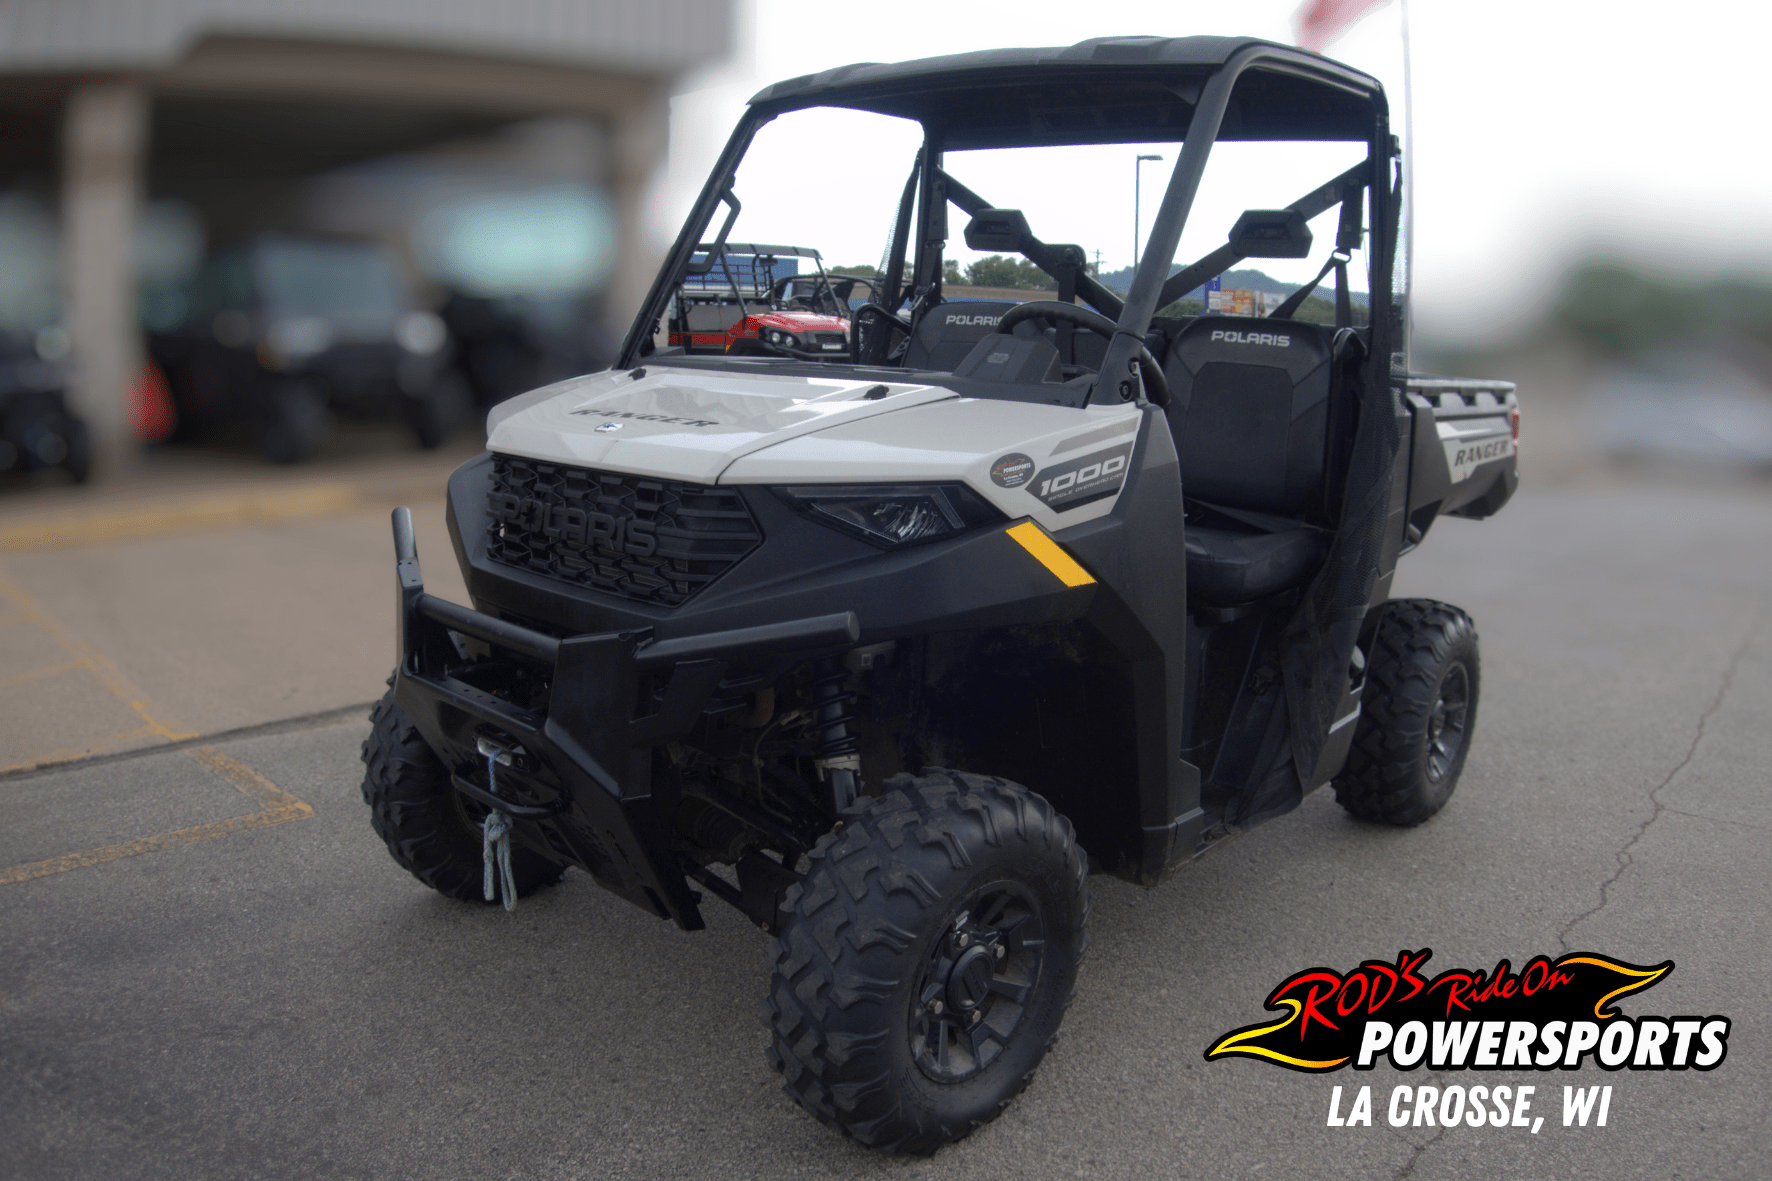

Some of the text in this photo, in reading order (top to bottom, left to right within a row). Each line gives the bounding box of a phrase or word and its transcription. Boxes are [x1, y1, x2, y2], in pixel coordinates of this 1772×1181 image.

[1210, 330, 1291, 348] POLARIS
[568, 409, 720, 427] RANGER
[1454, 439, 1509, 467] RANGER
[1040, 454, 1126, 497] 1000
[1048, 489, 1073, 502] SINGLE
[1075, 476, 1109, 492] OVERHEAD
[500, 492, 657, 557] POLARIS
